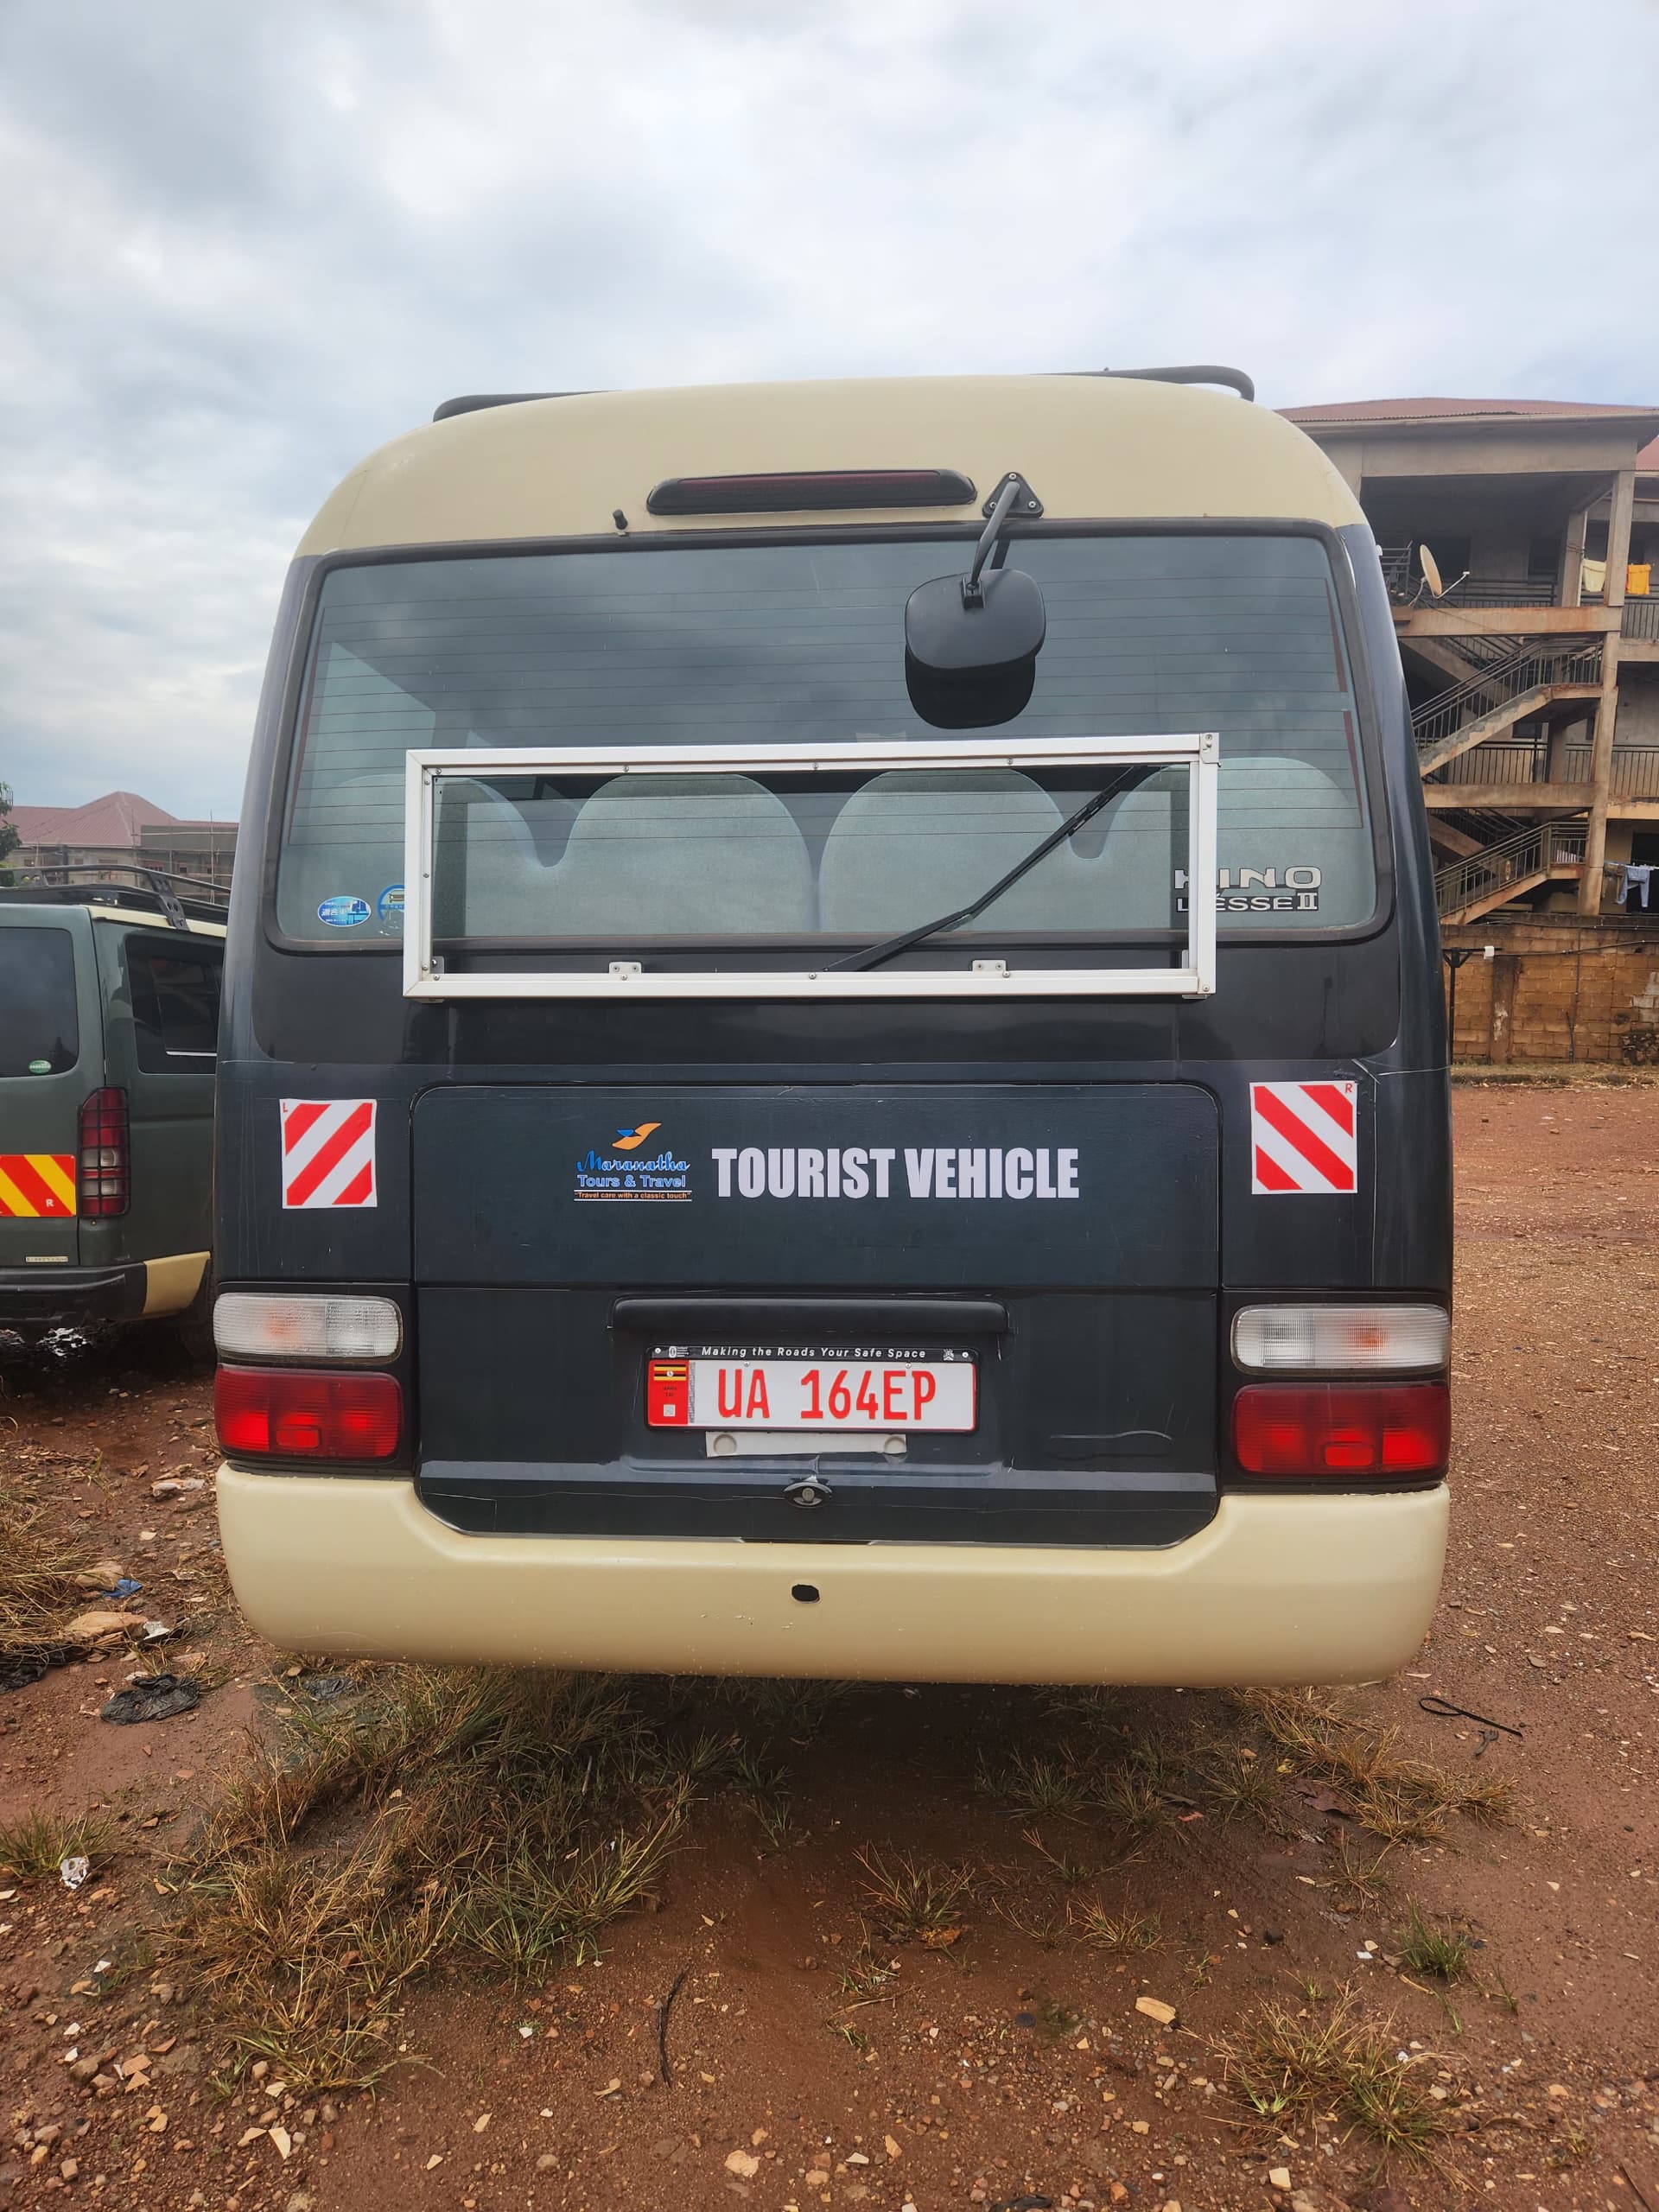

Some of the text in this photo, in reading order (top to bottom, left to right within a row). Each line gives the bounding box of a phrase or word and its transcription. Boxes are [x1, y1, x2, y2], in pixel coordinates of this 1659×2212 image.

[1345, 1084, 1352, 1092] R
[576, 1150, 690, 1172] Maranatha
[712, 1147, 1079, 1199] TOURIST VEHICLE
[577, 1175, 686, 1187] Tours & Travel
[46, 1198, 54, 1207] R
[702, 1346, 926, 1359] Making the Roads Your Safe Space
[718, 1369, 770, 1419] UA
[800, 1370, 937, 1421] 164EP
